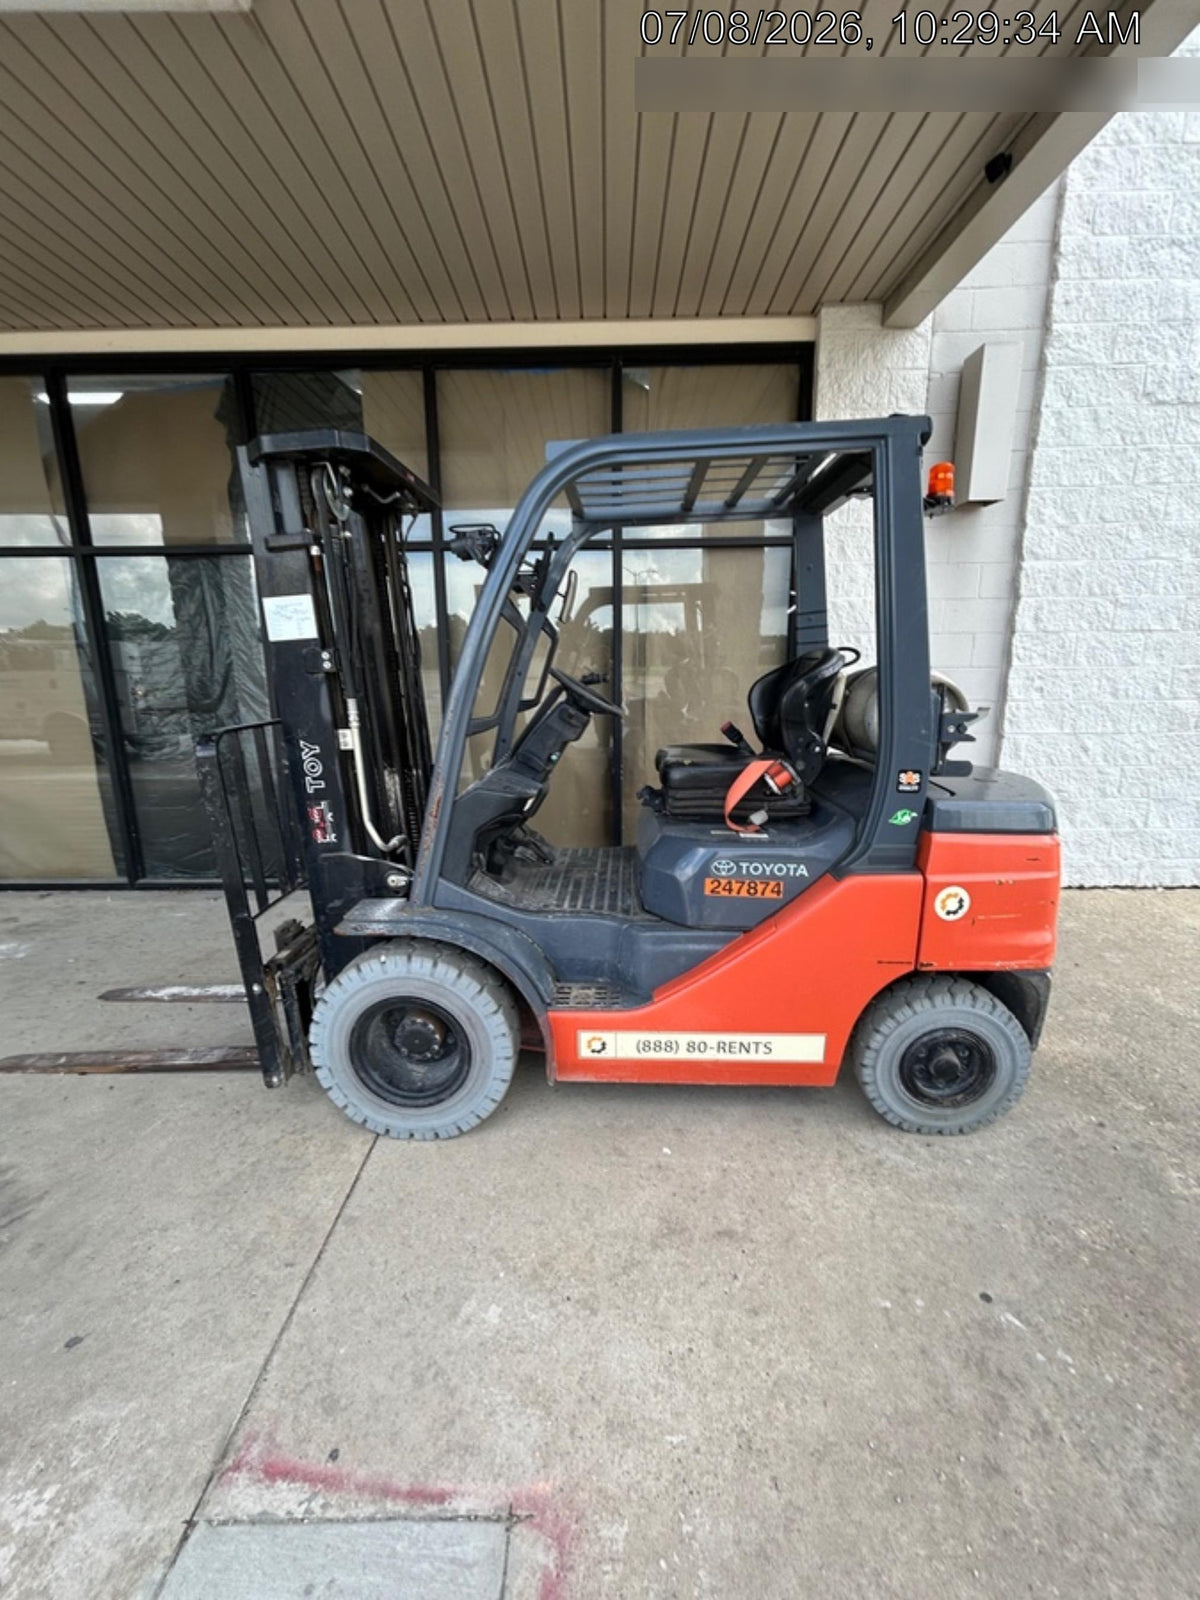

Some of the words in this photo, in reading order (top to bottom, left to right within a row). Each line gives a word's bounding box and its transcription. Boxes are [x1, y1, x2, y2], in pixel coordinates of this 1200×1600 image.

[300, 739, 326, 793] TOY
[739, 862, 809, 877] TOYOTA
[710, 879, 782, 896] 247874
[635, 1039, 680, 1054] (888)
[686, 1041, 773, 1055] 80-RENTS
